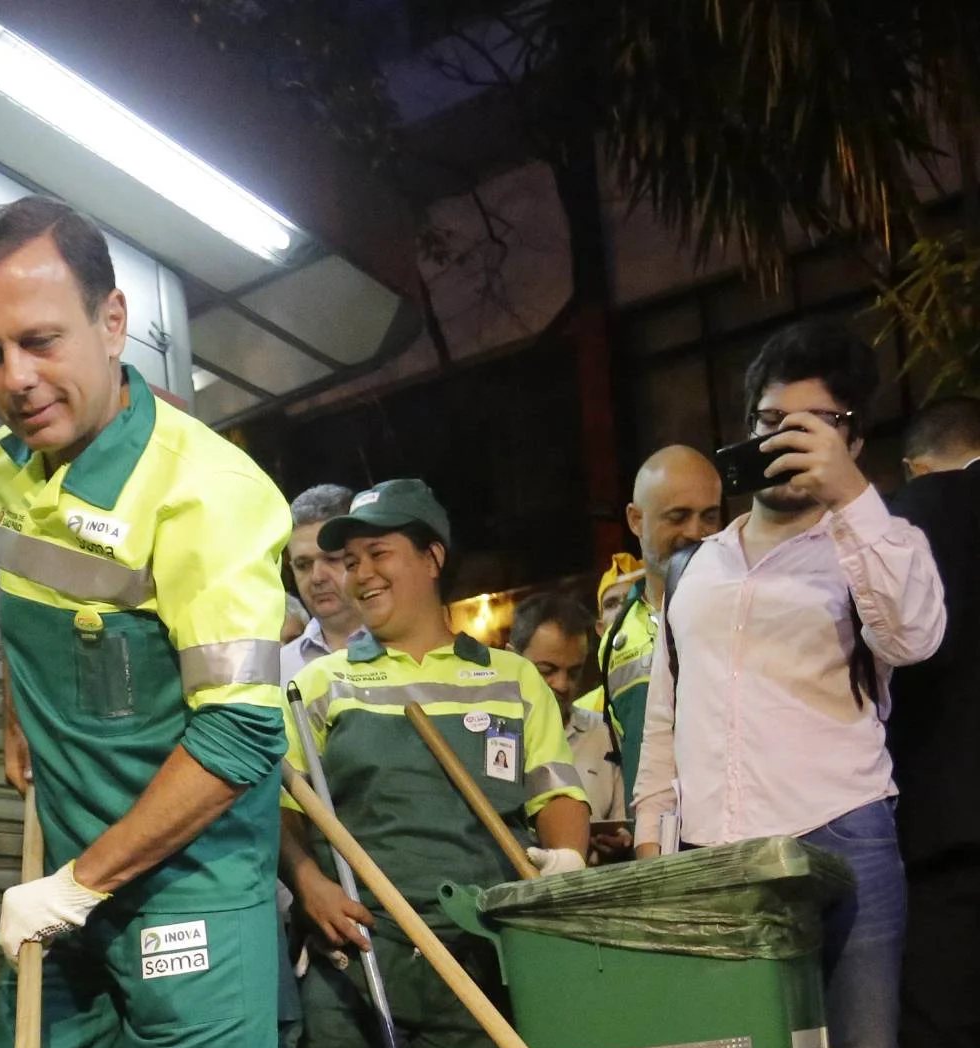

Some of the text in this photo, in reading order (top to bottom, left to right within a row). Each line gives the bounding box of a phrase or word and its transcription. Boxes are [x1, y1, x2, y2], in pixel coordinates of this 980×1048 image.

[85, 520, 120, 538] INOVA
[164, 928, 201, 943] INOVA
[145, 952, 206, 976] soma
